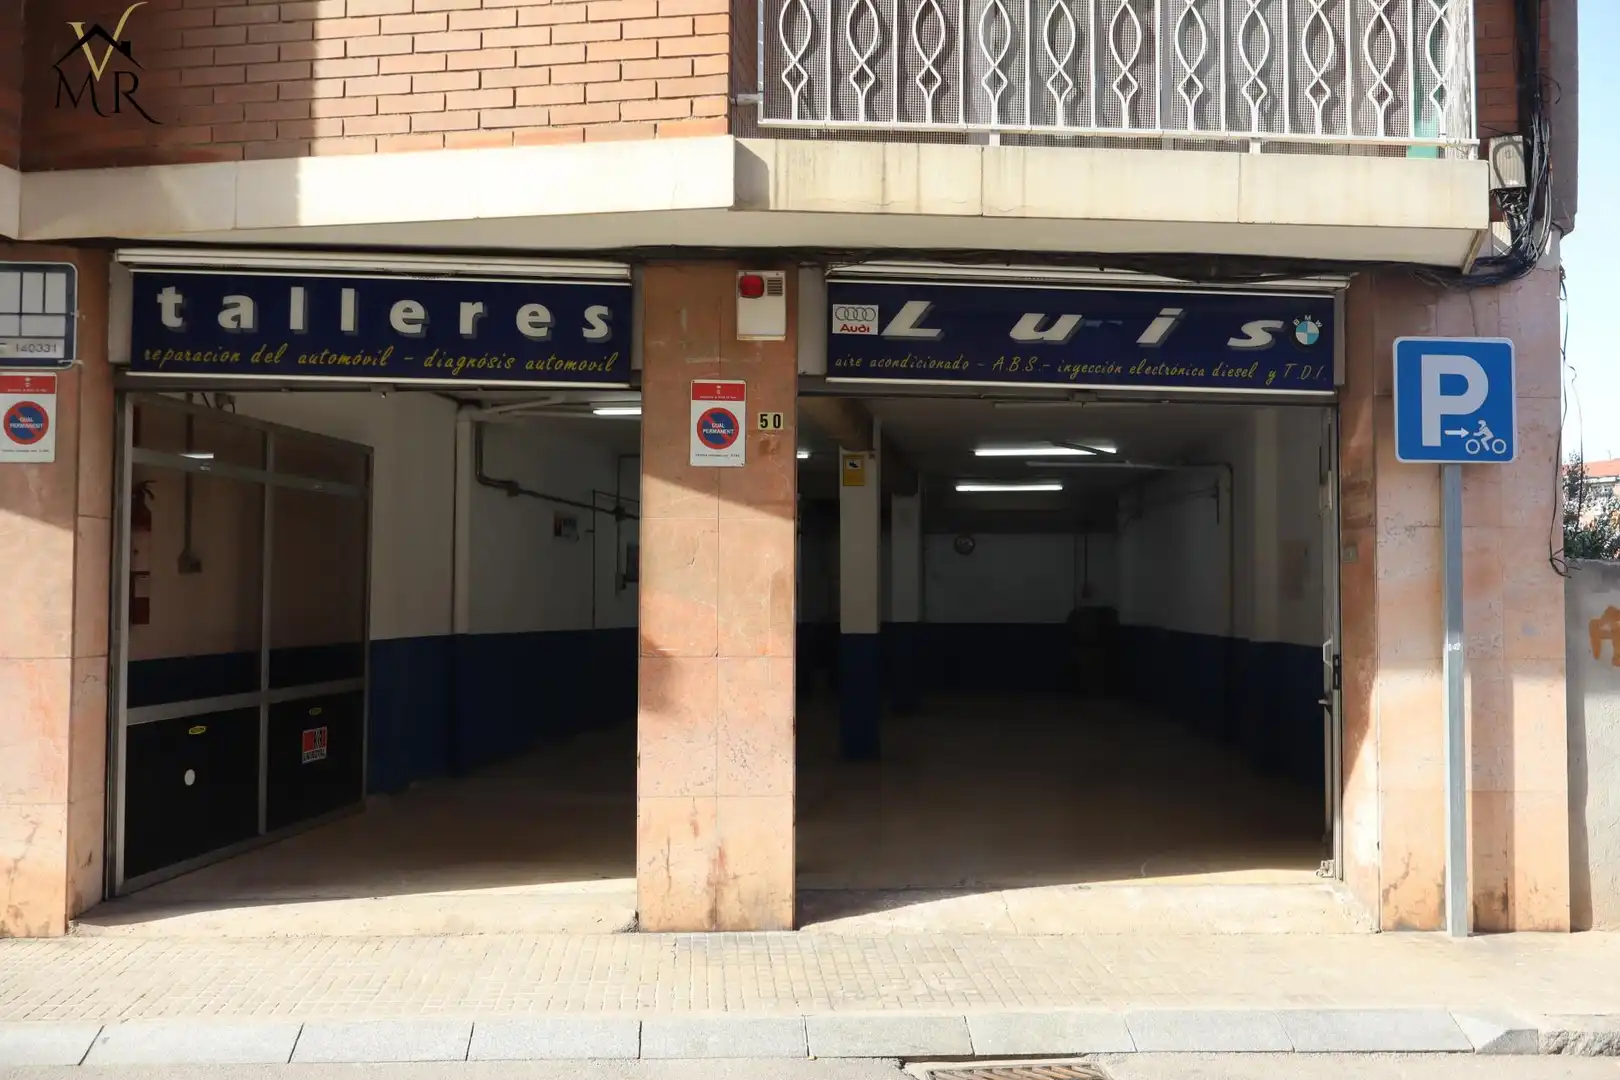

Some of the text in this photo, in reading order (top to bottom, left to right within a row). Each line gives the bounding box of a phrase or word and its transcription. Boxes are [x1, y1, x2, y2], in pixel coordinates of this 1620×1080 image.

[156, 285, 613, 343] talleres
[839, 323, 871, 334] Audi
[880, 300, 1286, 348] Luis
[251, 343, 288, 364] del
[298, 345, 394, 366] automóvil
[835, 354, 863, 368] aire
[870, 352, 969, 370] acondicionado
[1212, 361, 1258, 378] diesel
[1265, 371, 1276, 385] y
[1421, 354, 1489, 447] P
[760, 414, 782, 429] 50
